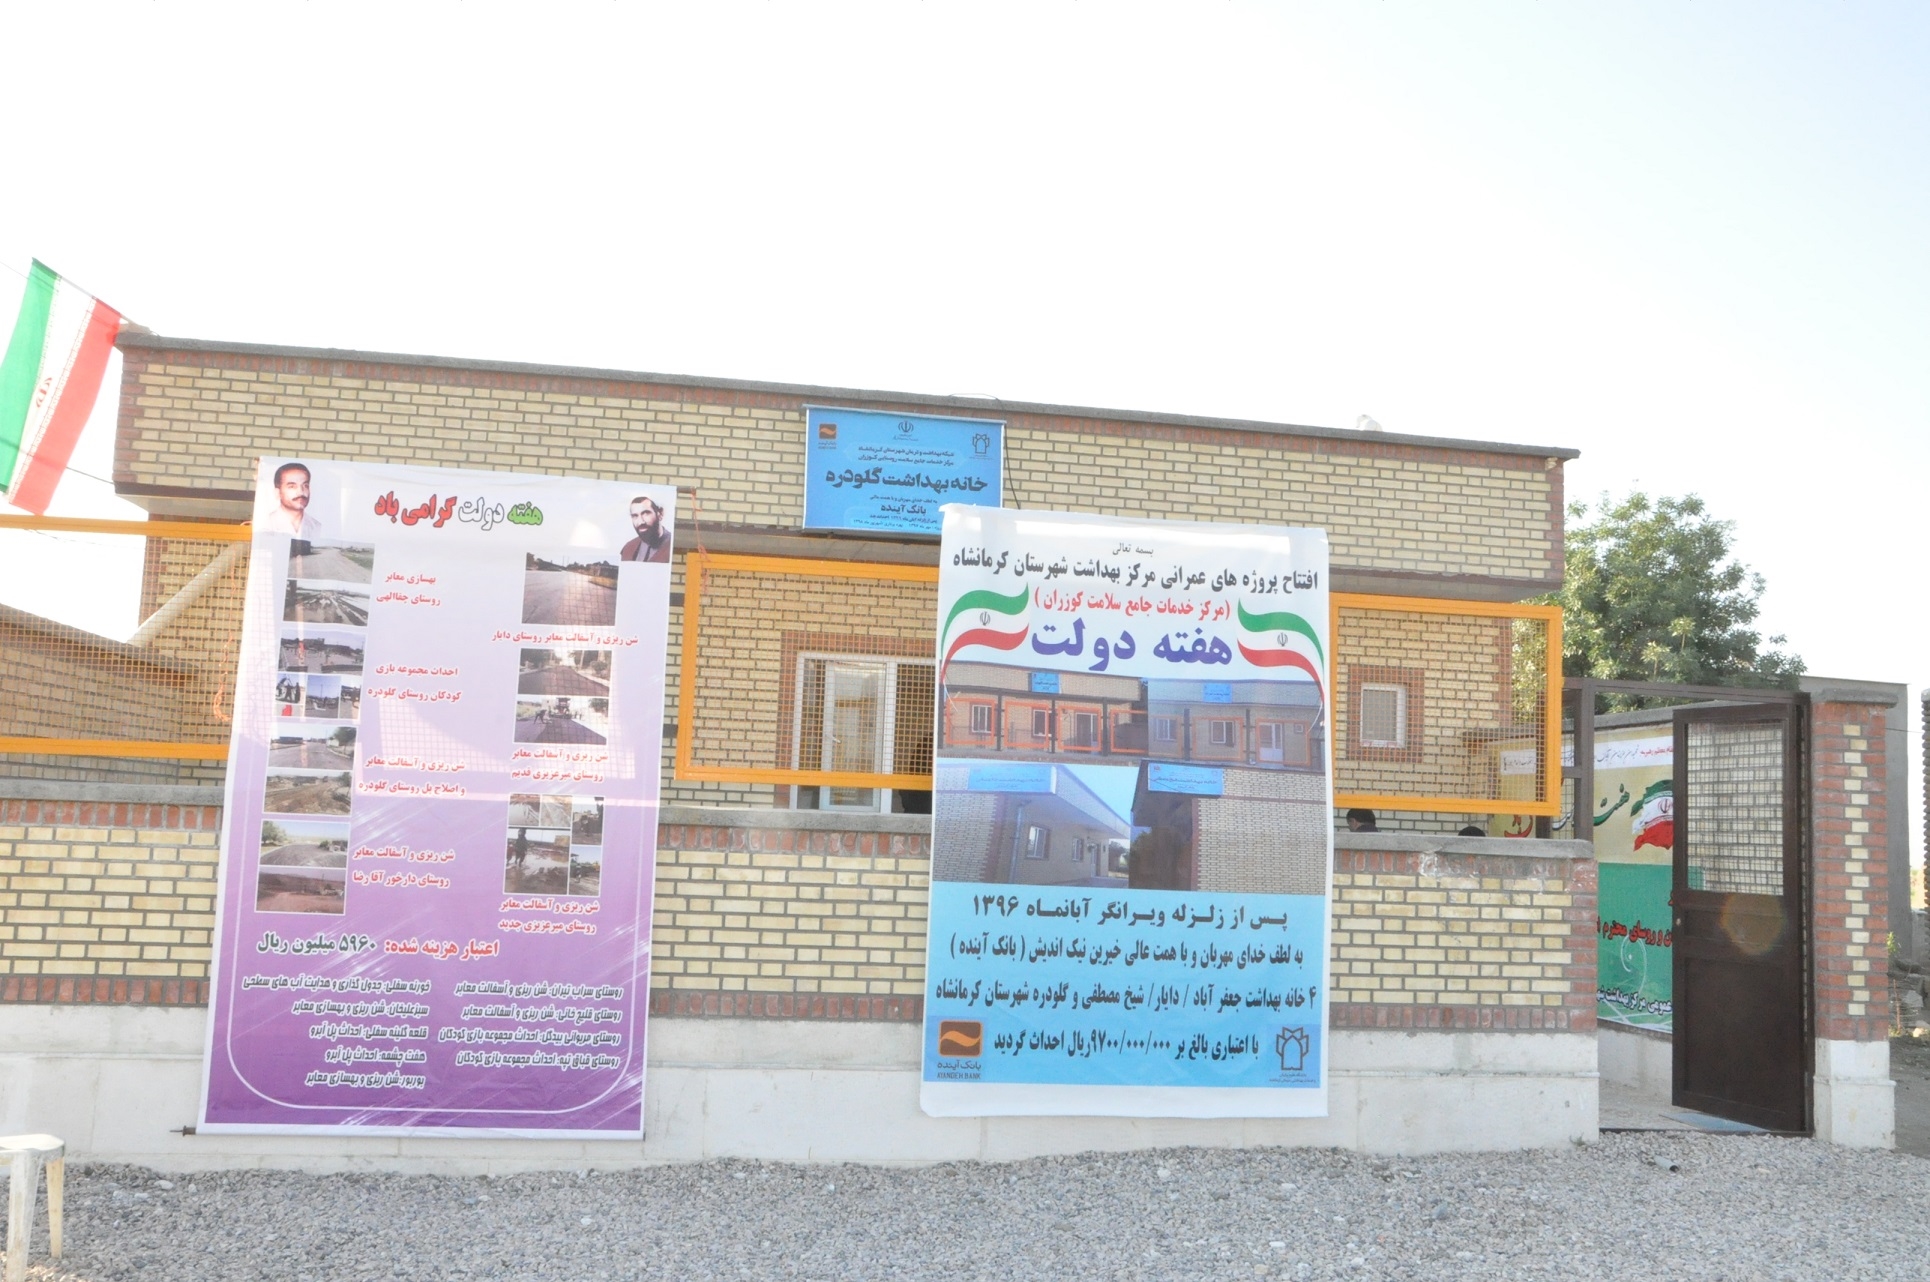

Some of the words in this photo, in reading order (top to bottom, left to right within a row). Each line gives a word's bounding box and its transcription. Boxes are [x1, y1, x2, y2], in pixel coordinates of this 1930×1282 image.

[825, 467, 882, 489] گلودره
[883, 473, 949, 494] بهداشت
[951, 476, 988, 492] خانه
[375, 491, 399, 523] باد
[401, 494, 457, 527] گرامی
[458, 497, 504, 531] دولت
[507, 501, 543, 525] هفته
[881, 504, 905, 514] آینده
[907, 504, 926, 516] بانک
[1112, 542, 1132, 556] تعالی
[1136, 546, 1154, 558] بسمه
[953, 547, 1008, 574] کرمانشاه
[1014, 552, 1068, 580] شهرستان
[385, 572, 405, 583] معابر
[1073, 558, 1120, 584] بهداشت
[1126, 562, 1156, 588] مرکز
[1161, 566, 1205, 590] عمرانی
[407, 573, 436, 584] بهسازی
[1212, 568, 1237, 592] های
[1242, 570, 1278, 594] پروژه
[1283, 570, 1318, 593] افتتاح
[411, 595, 440, 606] روستای
[1044, 589, 1084, 612] کوزران
[1087, 592, 1121, 610] سلامت
[1125, 595, 1152, 616] جامع
[1157, 598, 1194, 615] خدمات
[512, 631, 542, 643] روستای
[544, 632, 563, 643] معابر
[566, 632, 594, 642] آسفالت
[602, 634, 622, 645] ریزی
[1032, 617, 1136, 671] دولت
[1153, 627, 1232, 665] هفته
[376, 664, 395, 674] بازی
[398, 665, 428, 676] مجموعه
[431, 667, 458, 675] احداث
[398, 689, 428, 701] روستای
[431, 691, 461, 702] کودکان
[512, 748, 531, 759] معابر
[534, 748, 563, 758] آسفالت
[572, 753, 592, 762] ریزی
[366, 756, 385, 767] معابر
[388, 757, 419, 767] آسفالت
[428, 761, 449, 771] ریزی
[452, 761, 465, 772] شن
[512, 767, 531, 778] قدیم
[574, 770, 603, 782] روستای
[389, 782, 419, 794] روستای
[435, 784, 458, 794] اصلاح
[354, 847, 374, 859] معابر
[376, 847, 407, 857] آسفالت
[416, 850, 438, 861] ریزی
[440, 850, 454, 862] شن
[353, 872, 368, 885] رضا
[371, 872, 384, 881] آقا
[419, 874, 449, 887] روستای
[500, 899, 520, 910] معابر
[523, 899, 552, 909] آسفالت
[562, 902, 583, 913] ریزی
[585, 902, 599, 913] شن
[973, 895, 1019, 916] ۱۳۹۶
[1098, 901, 1165, 926] ویرانگر
[1172, 903, 1224, 929] زلزله
[1230, 905, 1244, 929] از
[500, 920, 521, 932] جدید
[565, 921, 595, 933] روستای
[1250, 912, 1287, 931] پس
[258, 933, 288, 953] ریال
[292, 935, 335, 955] میلیون
[339, 935, 376, 951] ۵۹۶۰
[386, 940, 418, 953] شده:
[423, 941, 458, 959] هزینه
[460, 940, 499, 960] اعتبار
[959, 932, 989, 960] آینده
[992, 935, 1016, 961] بانک
[1029, 937, 1063, 962] اندیش
[1066, 938, 1086, 963] نیک
[1090, 939, 1121, 965] خیرین
[1125, 939, 1149, 966] عالی
[1154, 945, 1176, 961] همت
[1181, 941, 1188, 967] با
[1200, 942, 1233, 969] مهربان
[1237, 943, 1265, 969] خدای
[1270, 943, 1291, 964] لطف
[1294, 948, 1303, 969] به
[243, 976, 270, 989] سطحی
[272, 977, 288, 989] های
[305, 978, 331, 989] هدایت
[361, 979, 382, 992] جدول
[515, 985, 532, 996] ریزی
[572, 986, 594, 998] سراب
[596, 986, 622, 998] روستای
[936, 978, 981, 1006] کرمانشاه
[985, 980, 1029, 1007] شهرستان
[1033, 982, 1069, 1009] گلودره
[1082, 983, 1120, 1009] مصطفی
[1124, 984, 1144, 1010] شیخ
[1193, 984, 1215, 1011] آباد
[1285, 986, 1305, 1006] خانه
[1309, 986, 1316, 1009] ۴
[1218, 987, 1241, 1013] جعفر
[1246, 987, 1281, 1012] بهداشت
[316, 1002, 344, 1014] بهسازی
[353, 1003, 369, 1015] ریزی
[522, 1007, 538, 1020] ریزی
[594, 1008, 622, 1022] روستای
[409, 1027, 427, 1038] قلعه
[439, 1028, 465, 1041] کودکان
[467, 1029, 483, 1042] بازی
[593, 1031, 621, 1045] روستای
[994, 1030, 1026, 1056] گردید
[1029, 1030, 1064, 1051] احداث
[1189, 1034, 1208, 1060] بالغ
[1211, 1034, 1248, 1061] اعتباری
[1175, 1038, 1185, 1060] بر
[1252, 1038, 1258, 1060] با
[457, 1052, 483, 1064] کودکان
[592, 1055, 619, 1068] روستای
[937, 1060, 960, 1070] آینده
[961, 1060, 981, 1071] بانک
[329, 1071, 358, 1085] بهسازی
